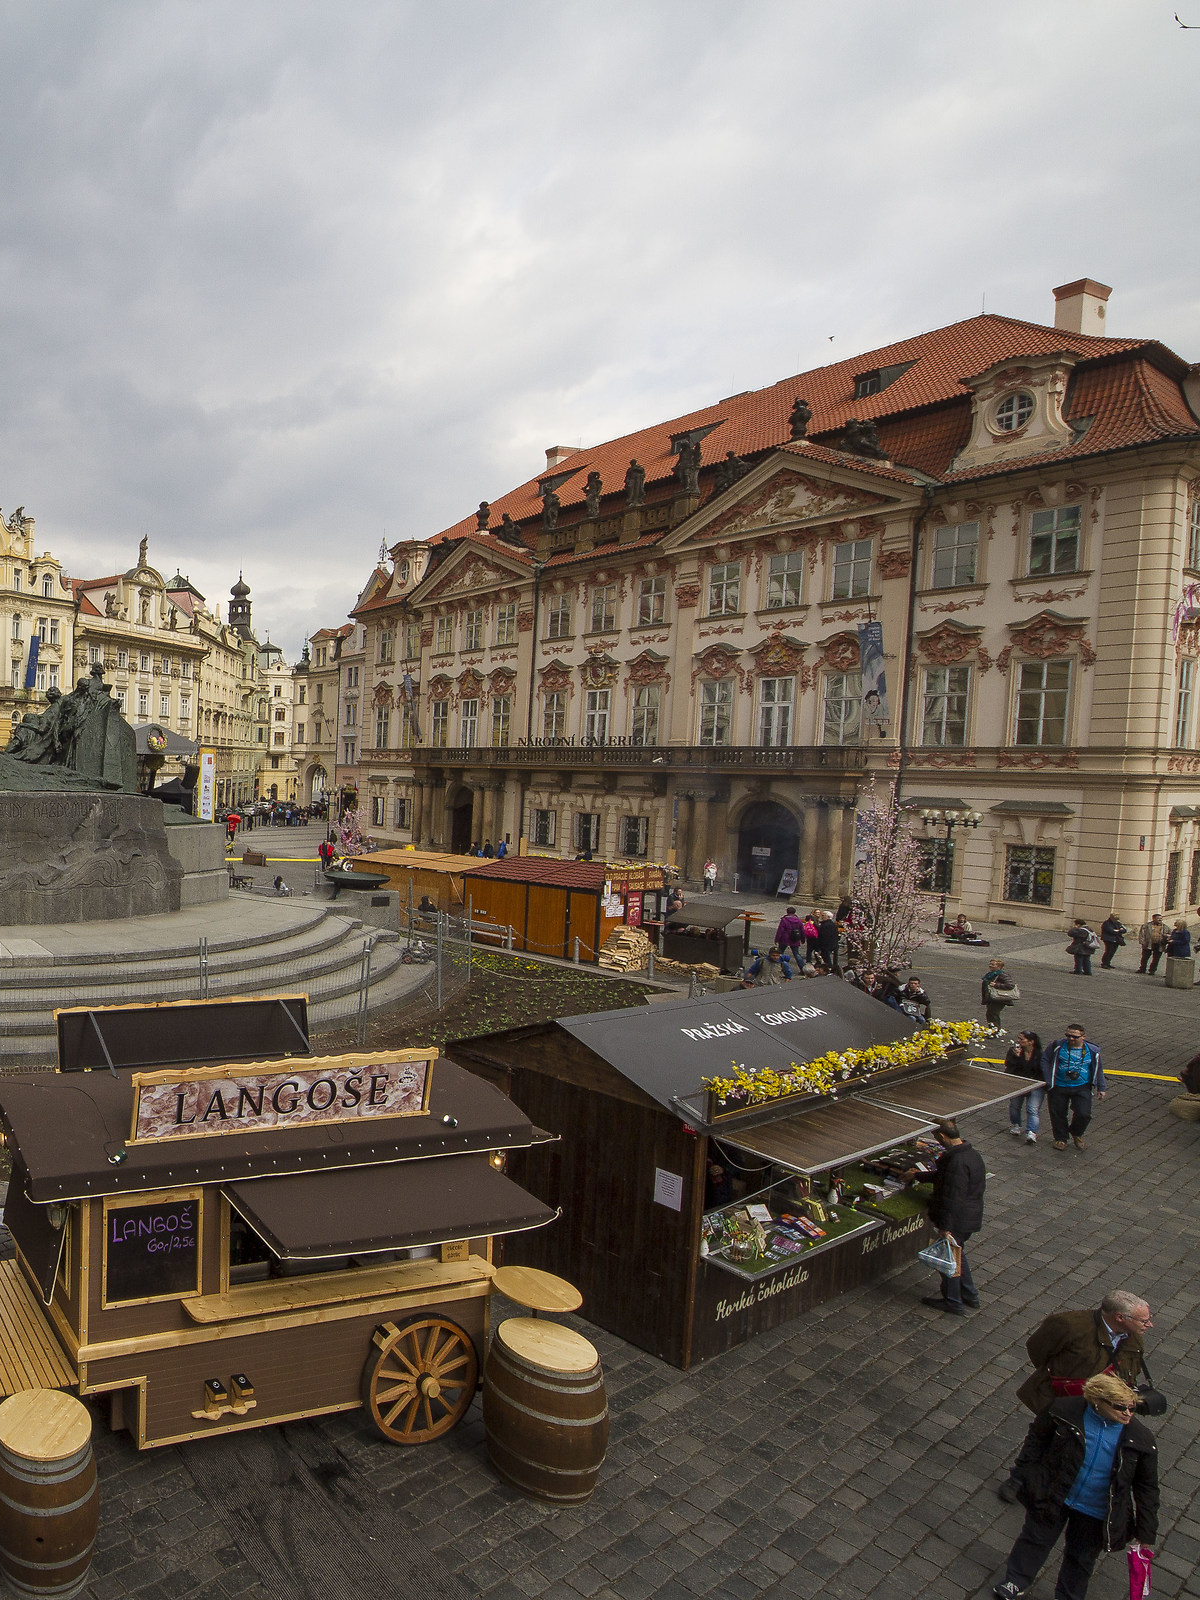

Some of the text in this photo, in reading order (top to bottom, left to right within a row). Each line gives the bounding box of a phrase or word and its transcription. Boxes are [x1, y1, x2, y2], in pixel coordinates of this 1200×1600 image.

[518, 734, 576, 747] NÁRODNÍ
[680, 1005, 828, 1041] PRAŽSKÁ ČOKOLÁDA
[173, 1069, 390, 1126] LANGOŠE
[113, 1205, 193, 1243] LANGOŠ
[861, 1213, 925, 1255] Hot Chocolate
[714, 1265, 810, 1322] Horká čokoláda
